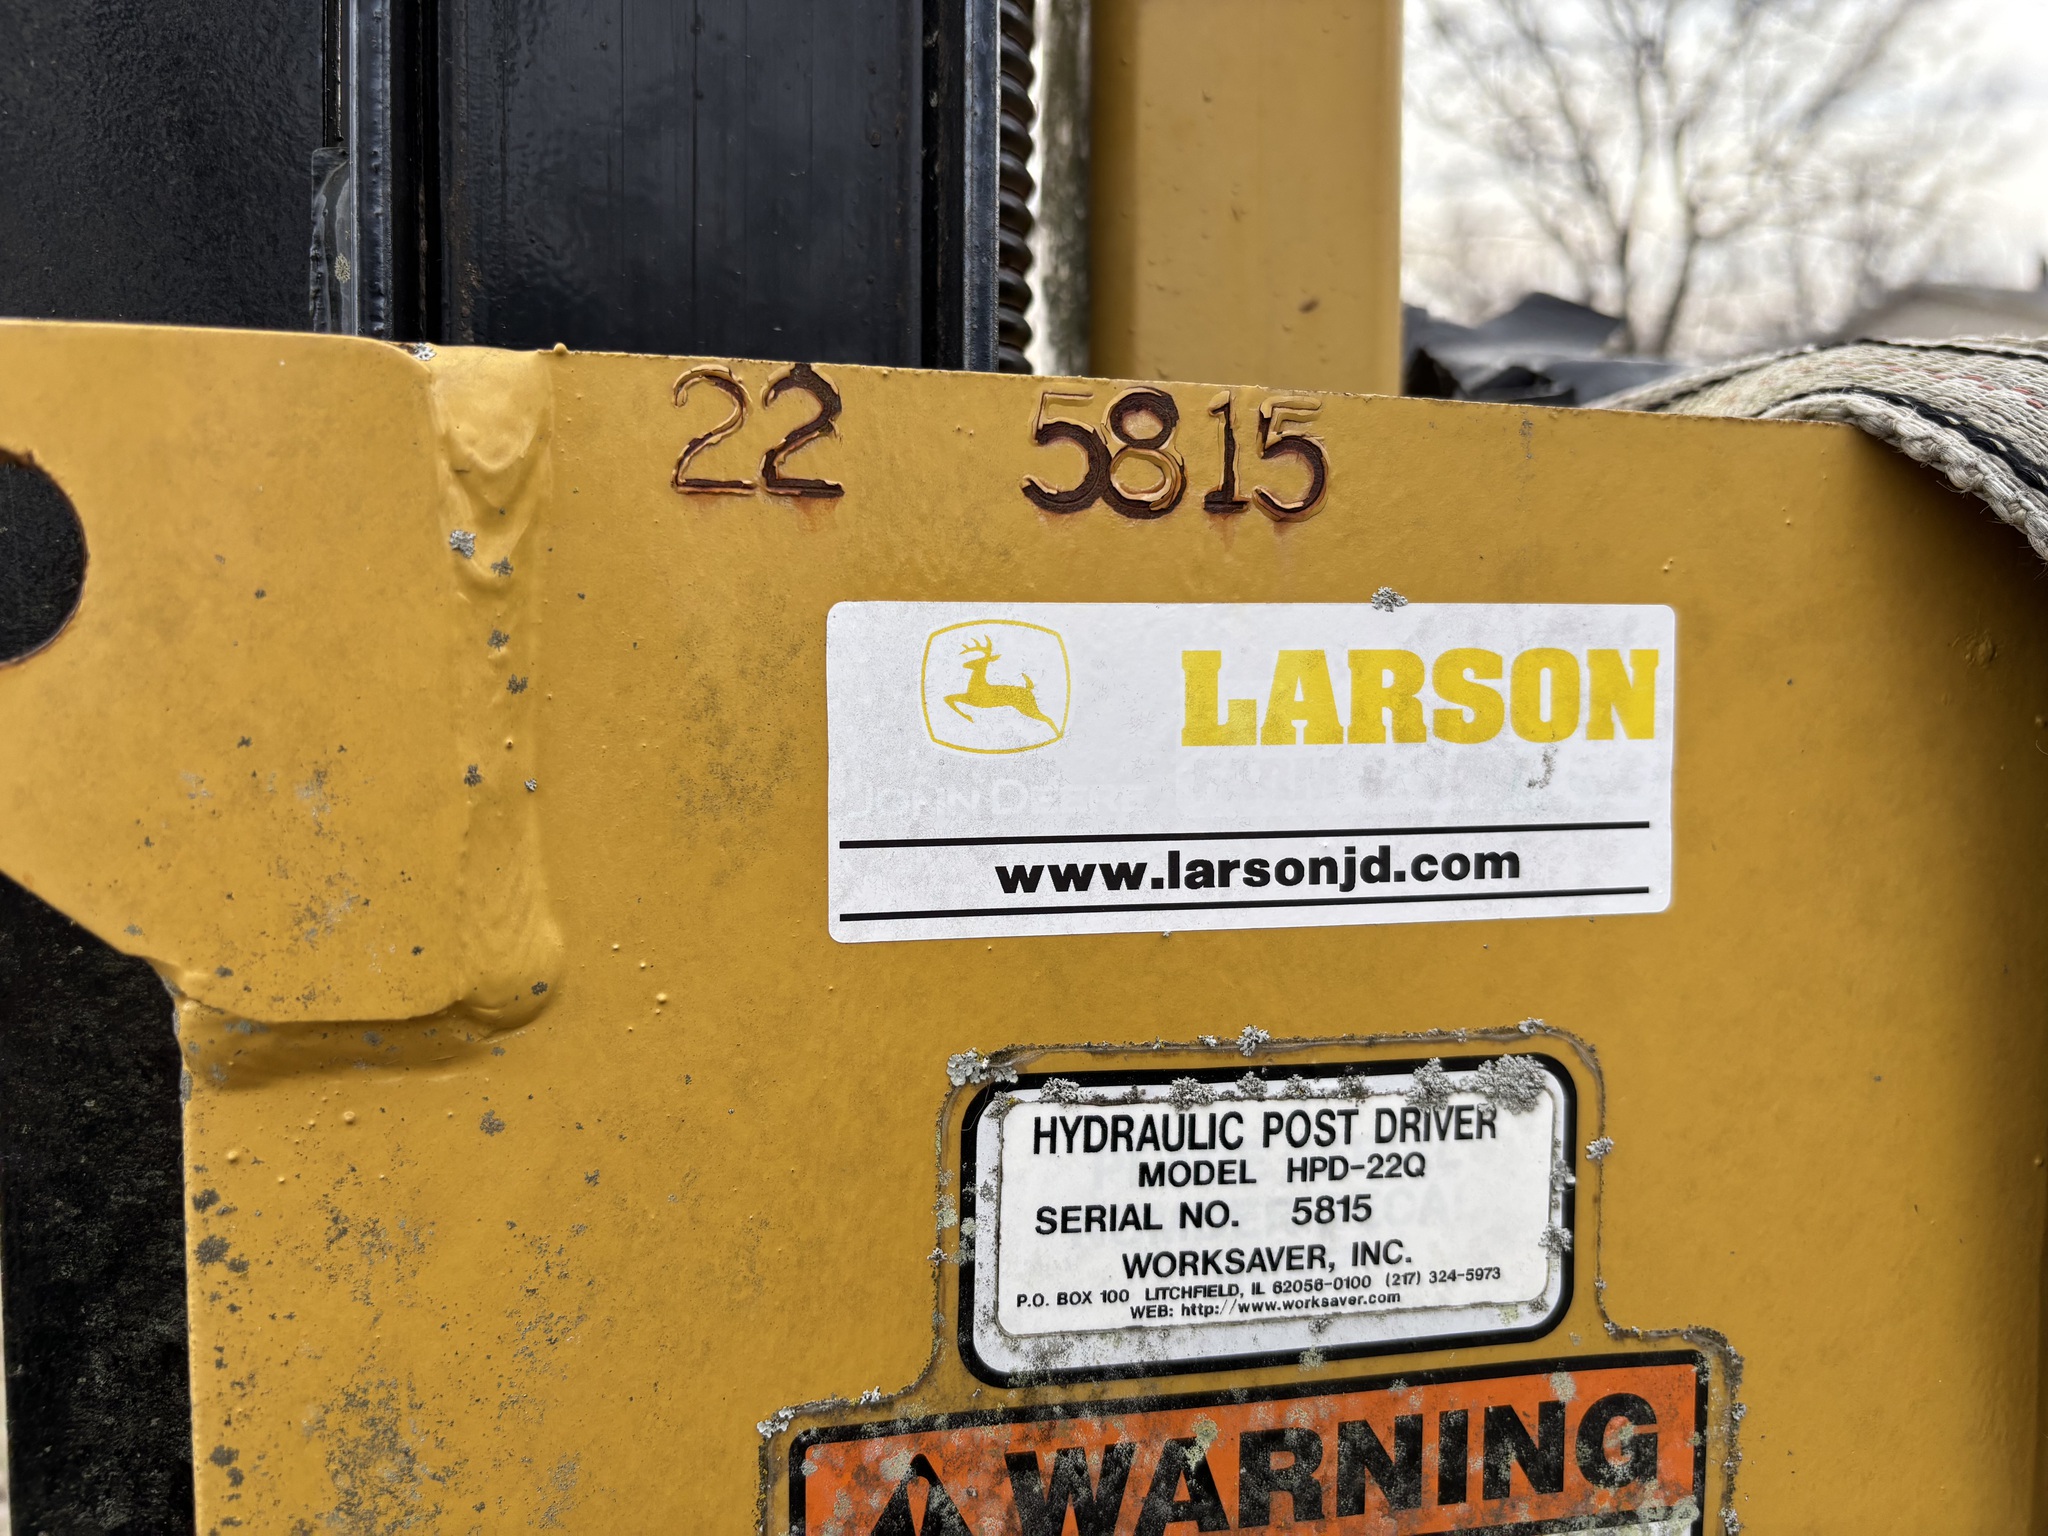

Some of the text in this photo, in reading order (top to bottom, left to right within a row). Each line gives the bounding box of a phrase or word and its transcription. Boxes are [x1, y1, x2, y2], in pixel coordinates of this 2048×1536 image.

[672, 362, 1328, 522] 22 5815
[1180, 647, 1659, 747] LARSON
[995, 845, 1522, 894] www.larsonjd.com
[1033, 1104, 1497, 1154] HYDRAULIC POST DRIVER
[1138, 1151, 1426, 1187] MODEL HPD-22Q
[1035, 1194, 1372, 1235] SERIAL NO. 5815
[1122, 1239, 1412, 1280] WORKSAVER, INC.
[1016, 1266, 1501, 1307] P.O. BOX 100 LITCHFIELD, IL 62056-0100 (217) 324-5973
[1130, 1292, 1401, 1319] WEB: http://www.worksaver.com
[1004, 1393, 1659, 1536] WARNING
